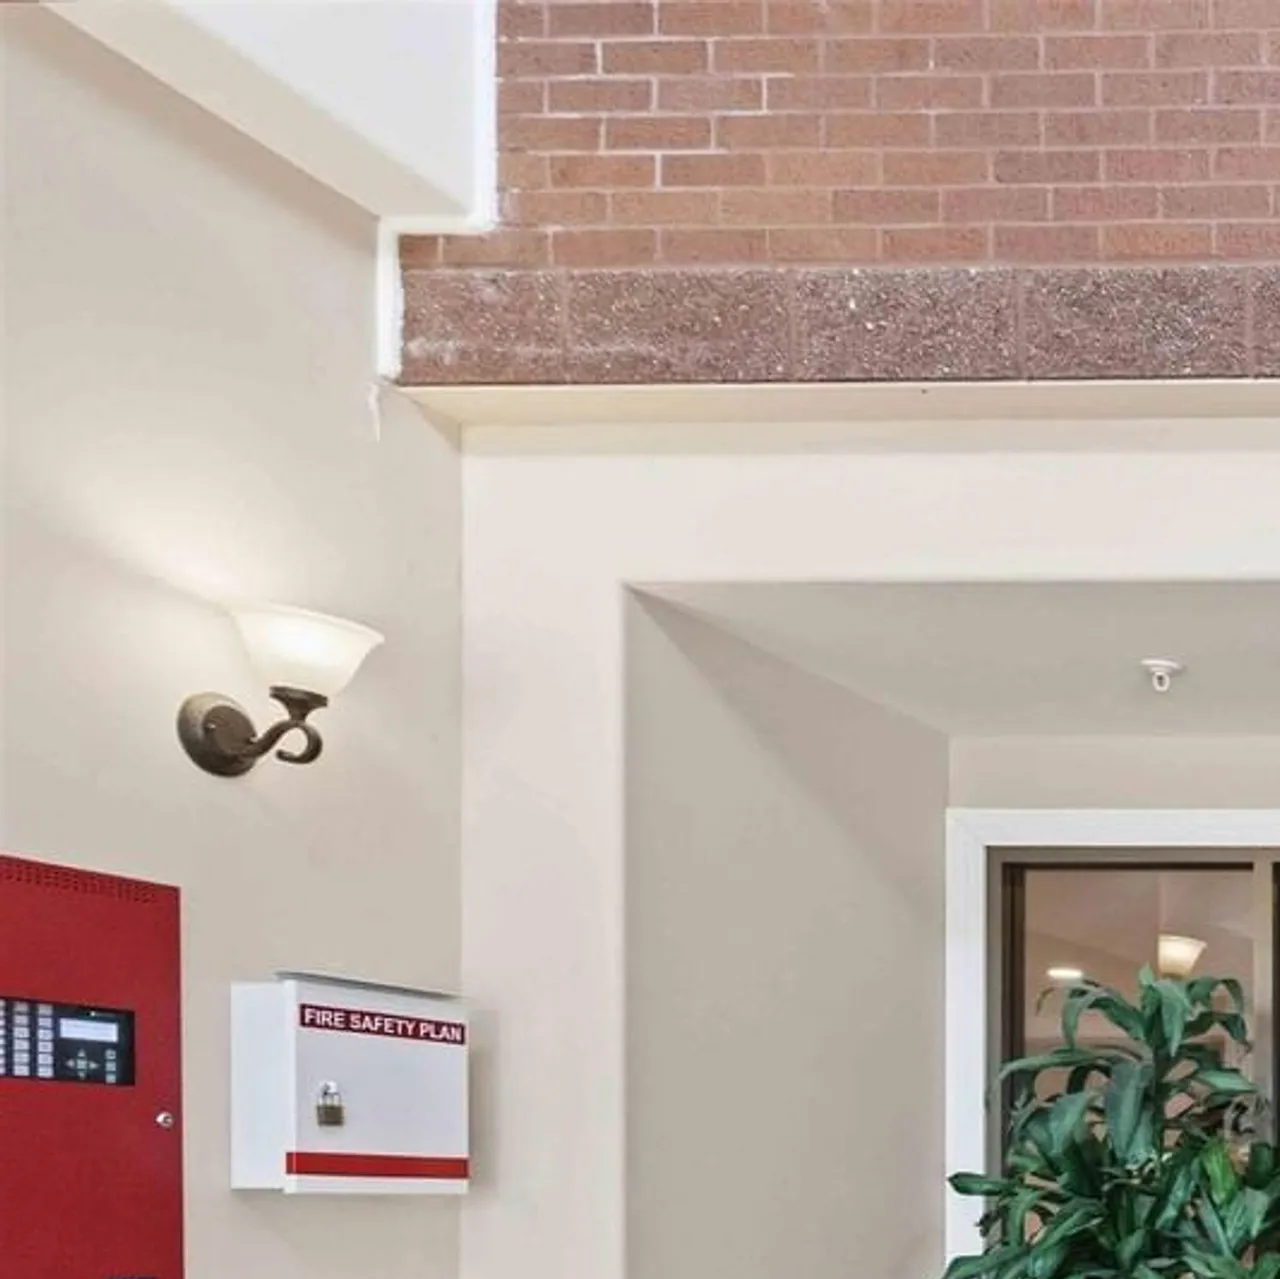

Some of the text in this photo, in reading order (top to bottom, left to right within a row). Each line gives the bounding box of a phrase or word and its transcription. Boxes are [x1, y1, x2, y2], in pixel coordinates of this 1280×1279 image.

[304, 1008, 462, 1042] FIRE SAFETY PLAN
